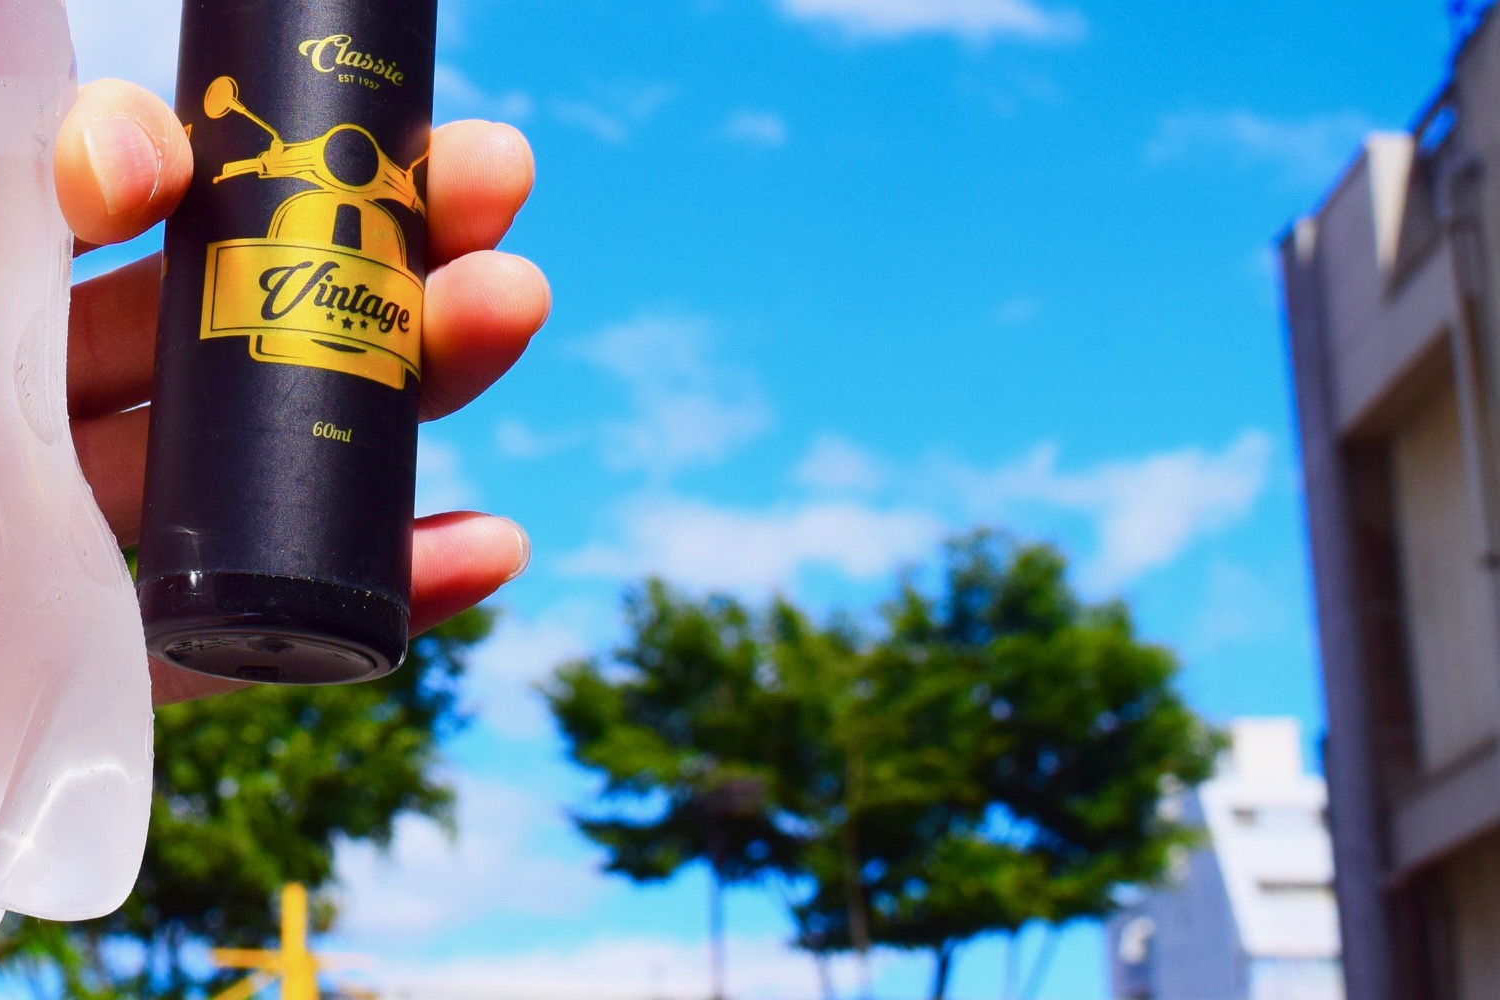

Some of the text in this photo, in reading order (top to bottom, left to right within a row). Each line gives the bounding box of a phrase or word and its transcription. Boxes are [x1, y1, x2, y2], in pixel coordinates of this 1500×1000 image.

[298, 34, 404, 86] Classic
[338, 73, 380, 90] EST 1957
[258, 260, 410, 334] Vintage
[312, 420, 353, 443] 60ml
